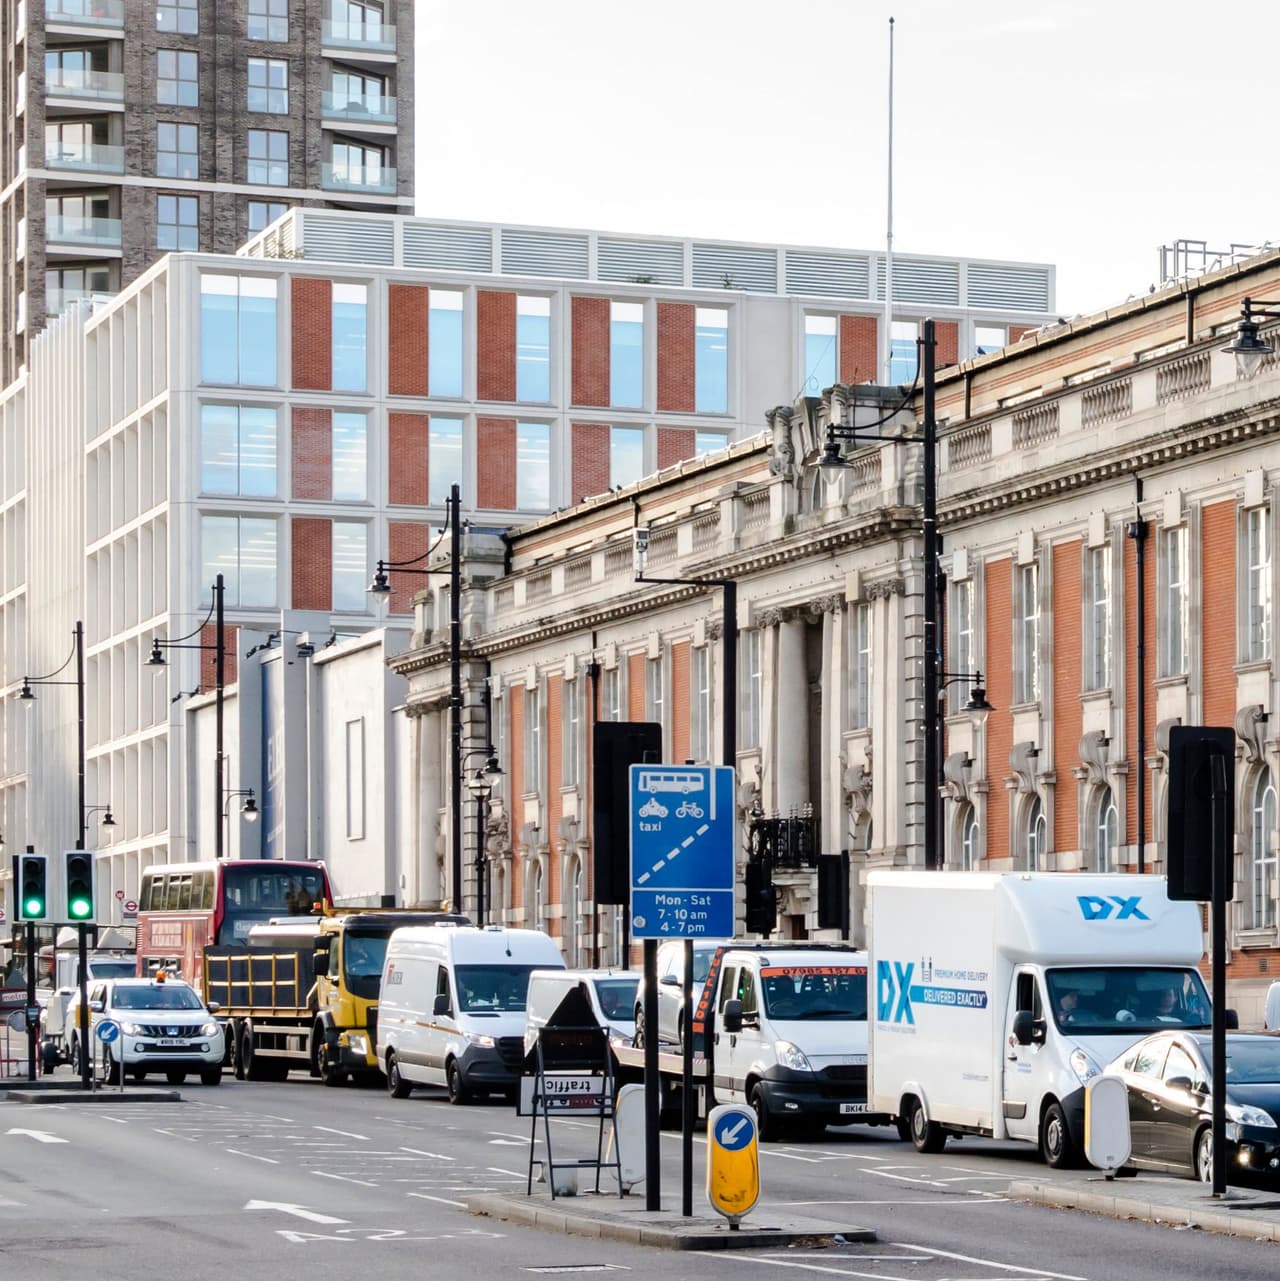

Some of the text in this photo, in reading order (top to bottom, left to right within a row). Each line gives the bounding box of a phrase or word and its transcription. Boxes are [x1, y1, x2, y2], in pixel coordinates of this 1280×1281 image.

[639, 821, 662, 831] taxi
[655, 895, 681, 905] Mon
[691, 895, 711, 905] Sat
[1077, 895, 1152, 920] DX
[690, 910, 707, 919] am
[688, 923, 705, 934] pm
[877, 960, 915, 1025] DX
[924, 989, 956, 1004] DELIVERED
[546, 1080, 591, 1092] traffic
